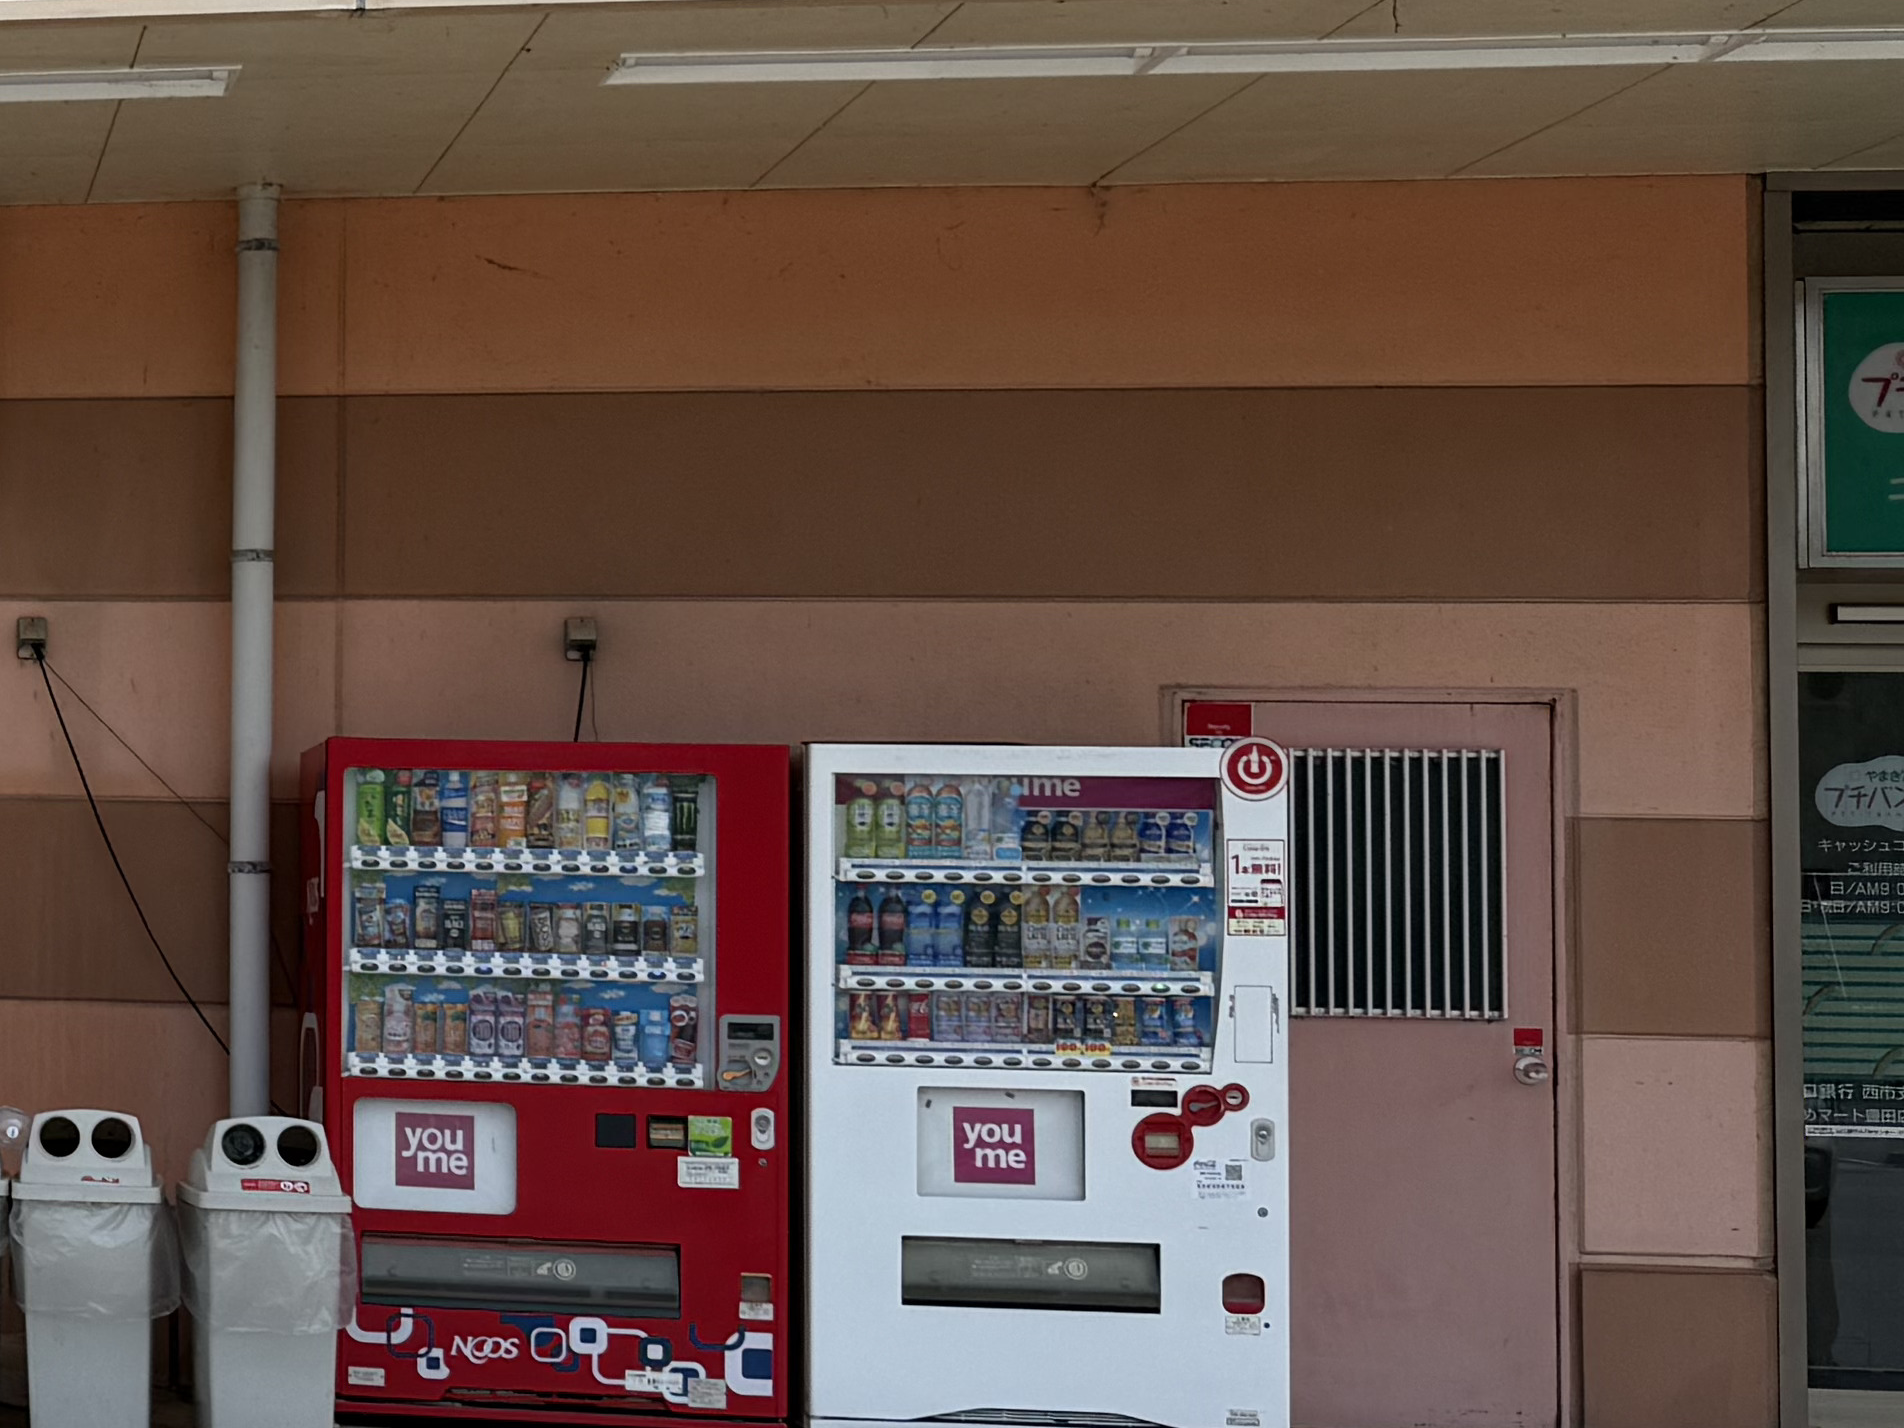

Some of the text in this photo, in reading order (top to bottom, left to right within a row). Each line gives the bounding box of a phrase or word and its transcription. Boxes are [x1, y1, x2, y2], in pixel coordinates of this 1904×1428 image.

[401, 1125, 465, 1158] you
[961, 1119, 1023, 1150] you
[415, 1152, 469, 1177] me
[973, 1145, 1028, 1171] me
